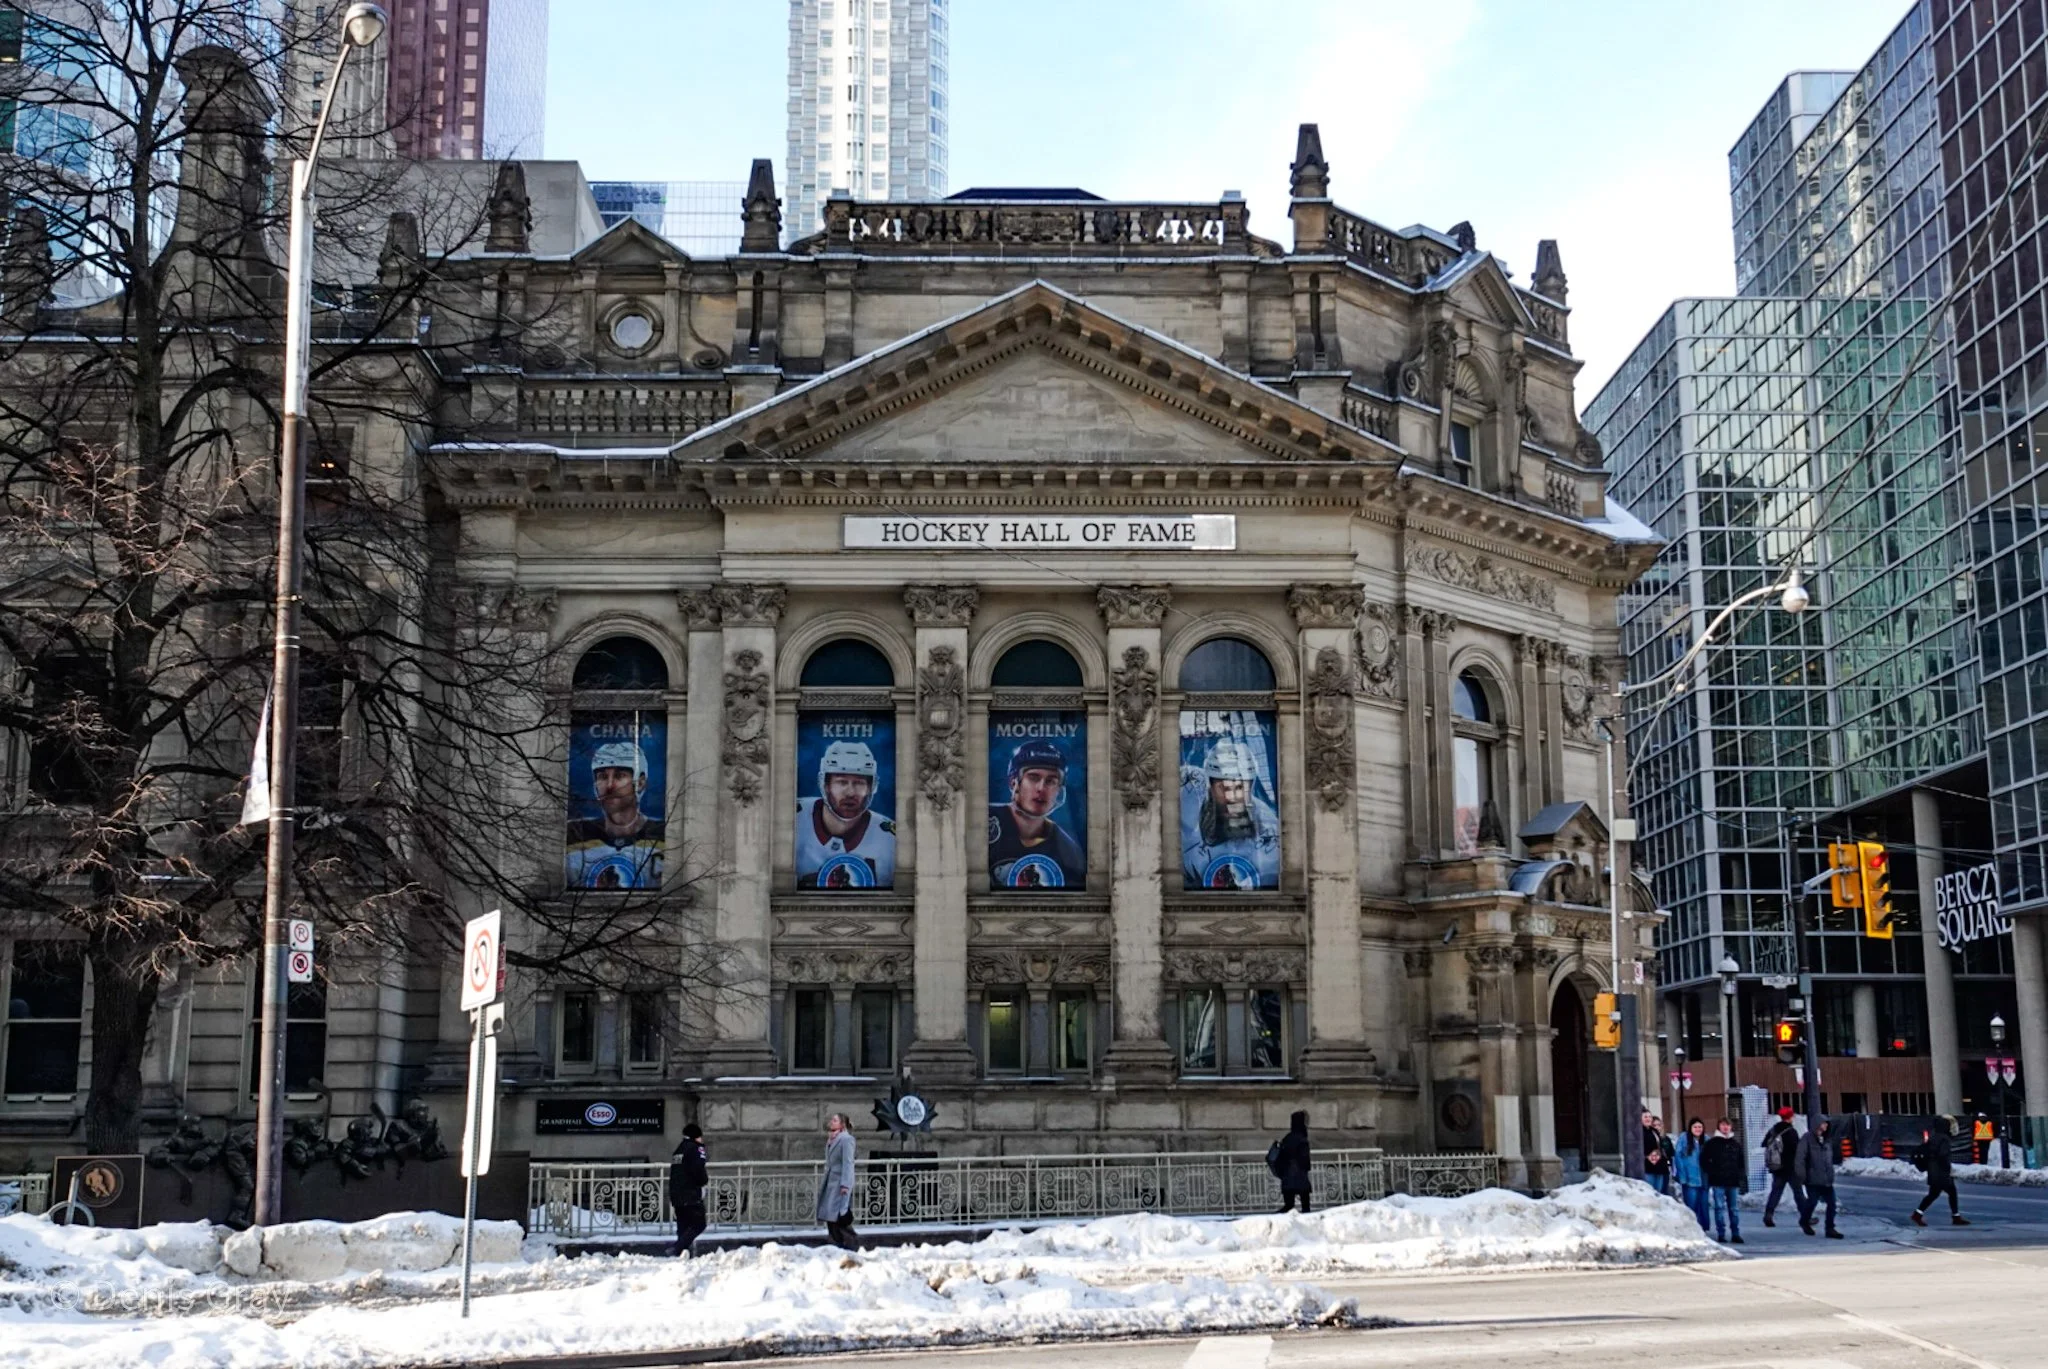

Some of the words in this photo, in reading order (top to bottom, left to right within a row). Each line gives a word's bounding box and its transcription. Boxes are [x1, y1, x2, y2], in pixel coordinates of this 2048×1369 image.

[881, 522, 989, 542] HOCKEY
[1000, 522, 1070, 542] HALL
[1082, 522, 1116, 542] OF
[1127, 522, 1196, 542] FAME
[822, 723, 874, 738] KEITH
[995, 723, 1079, 738] MOGILNY
[1934, 861, 2000, 912] BERCZY
